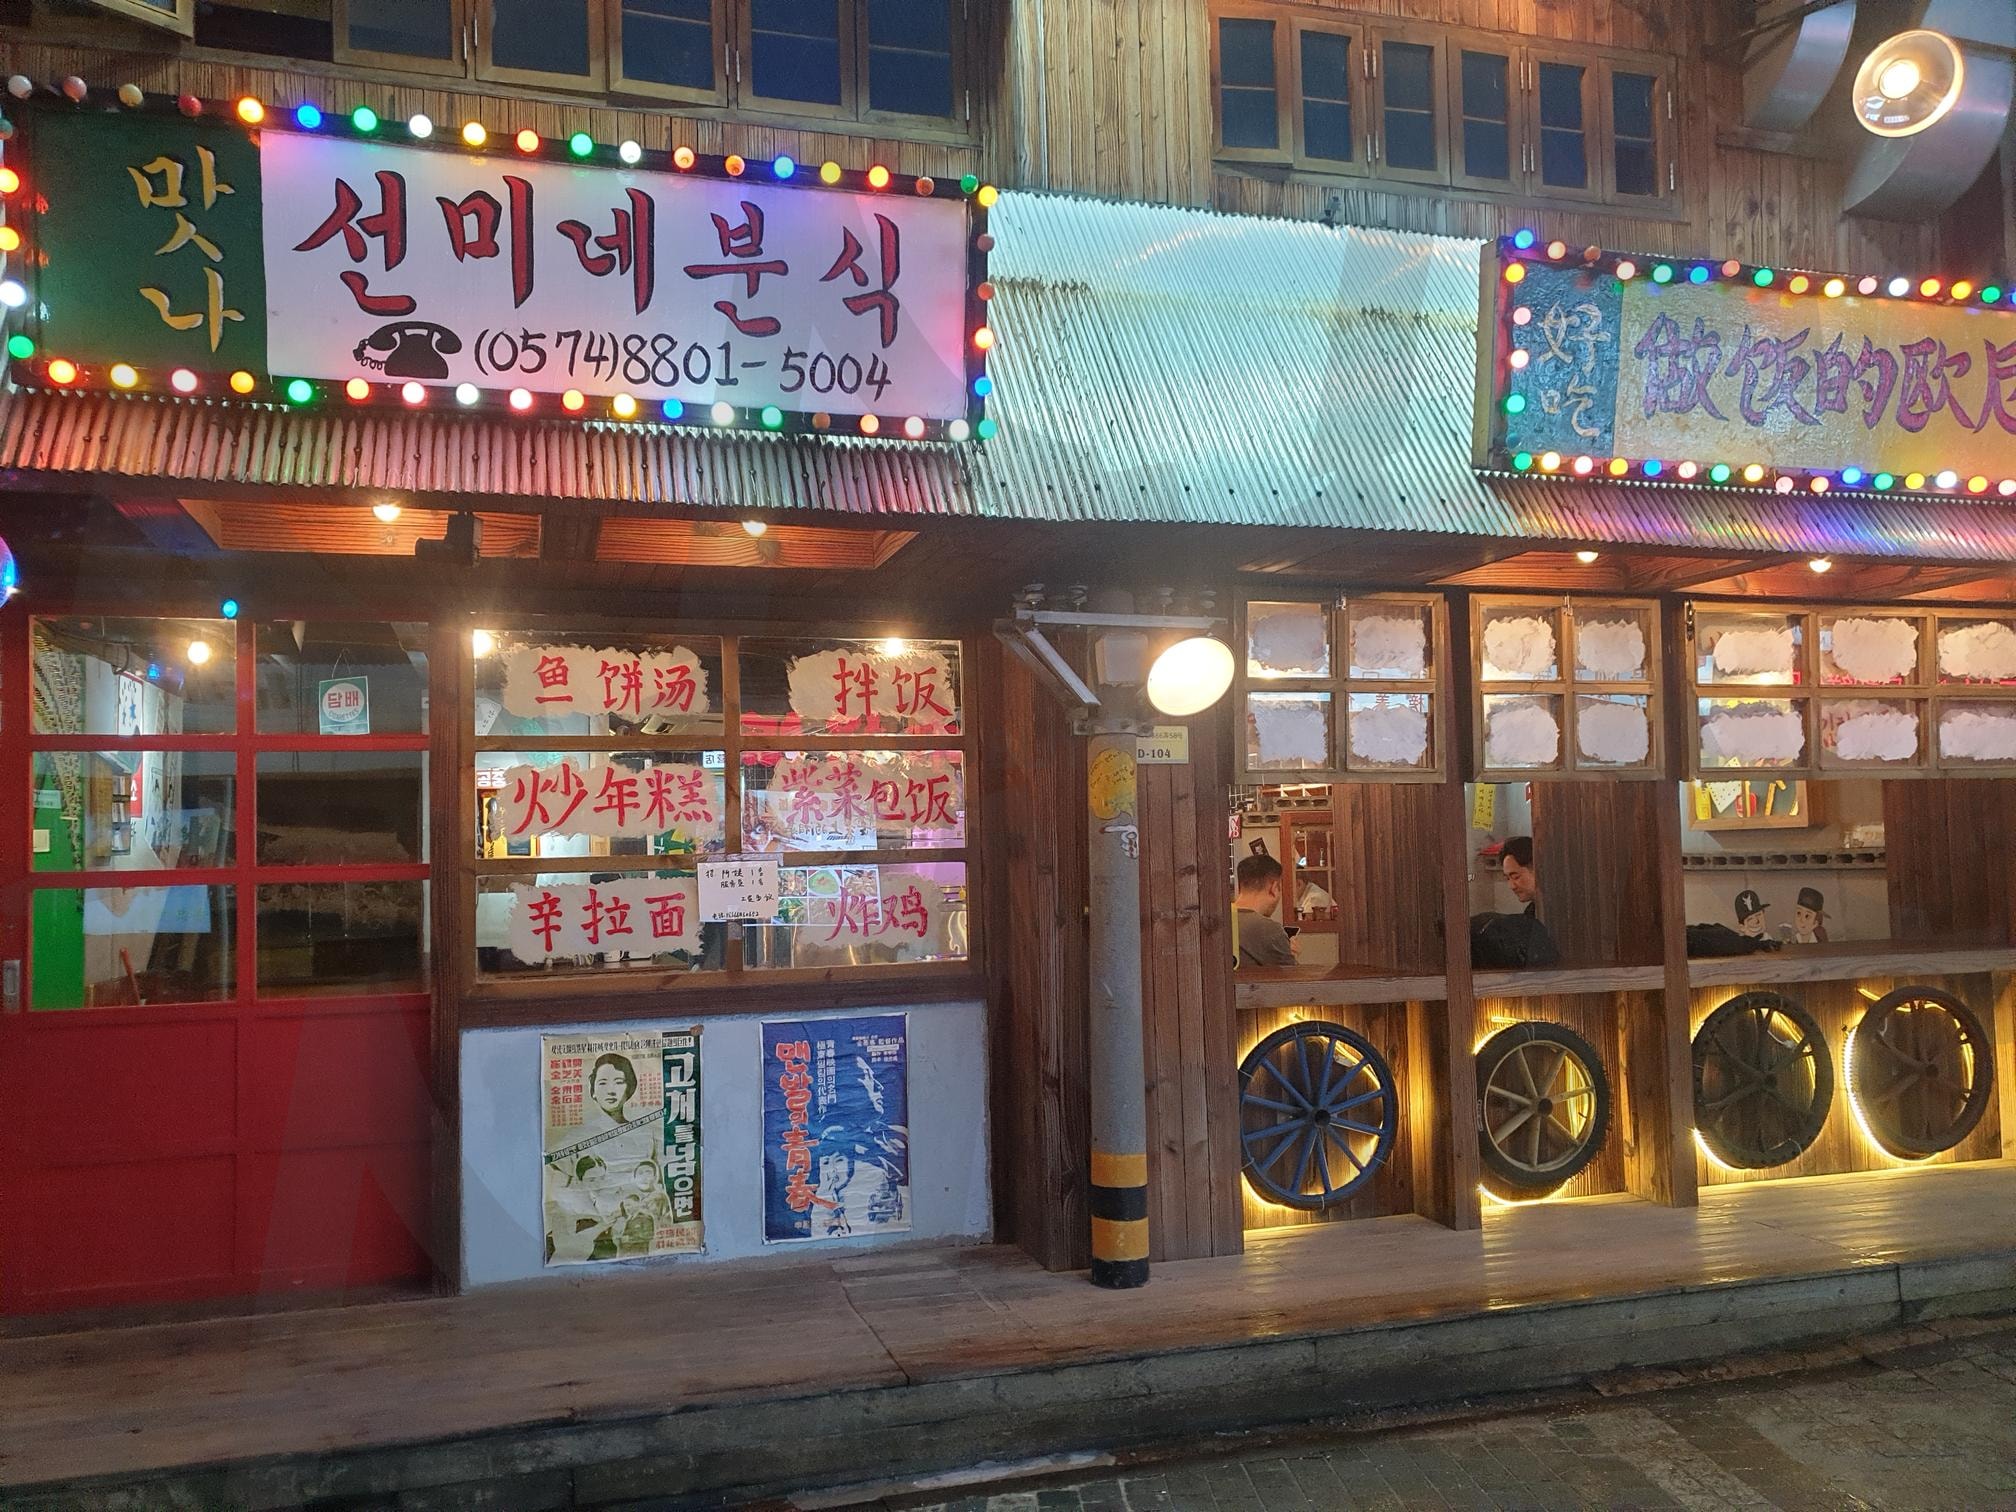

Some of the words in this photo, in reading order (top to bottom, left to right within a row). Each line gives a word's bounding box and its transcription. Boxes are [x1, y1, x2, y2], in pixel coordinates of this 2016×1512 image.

[128, 144, 247, 354] 맛나
[292, 168, 902, 351] 선미네분식
[1537, 300, 1612, 438] 好吃
[327, 690, 359, 709] 담배
[533, 655, 698, 716] 鱼饼汤
[833, 657, 954, 718] 拌饭
[1137, 748, 1171, 759] D-104
[511, 762, 714, 836] 炒年糕
[781, 762, 958, 827] 紫菜包饭
[527, 887, 685, 952] 辛拉面
[824, 886, 929, 941] 炸鸡
